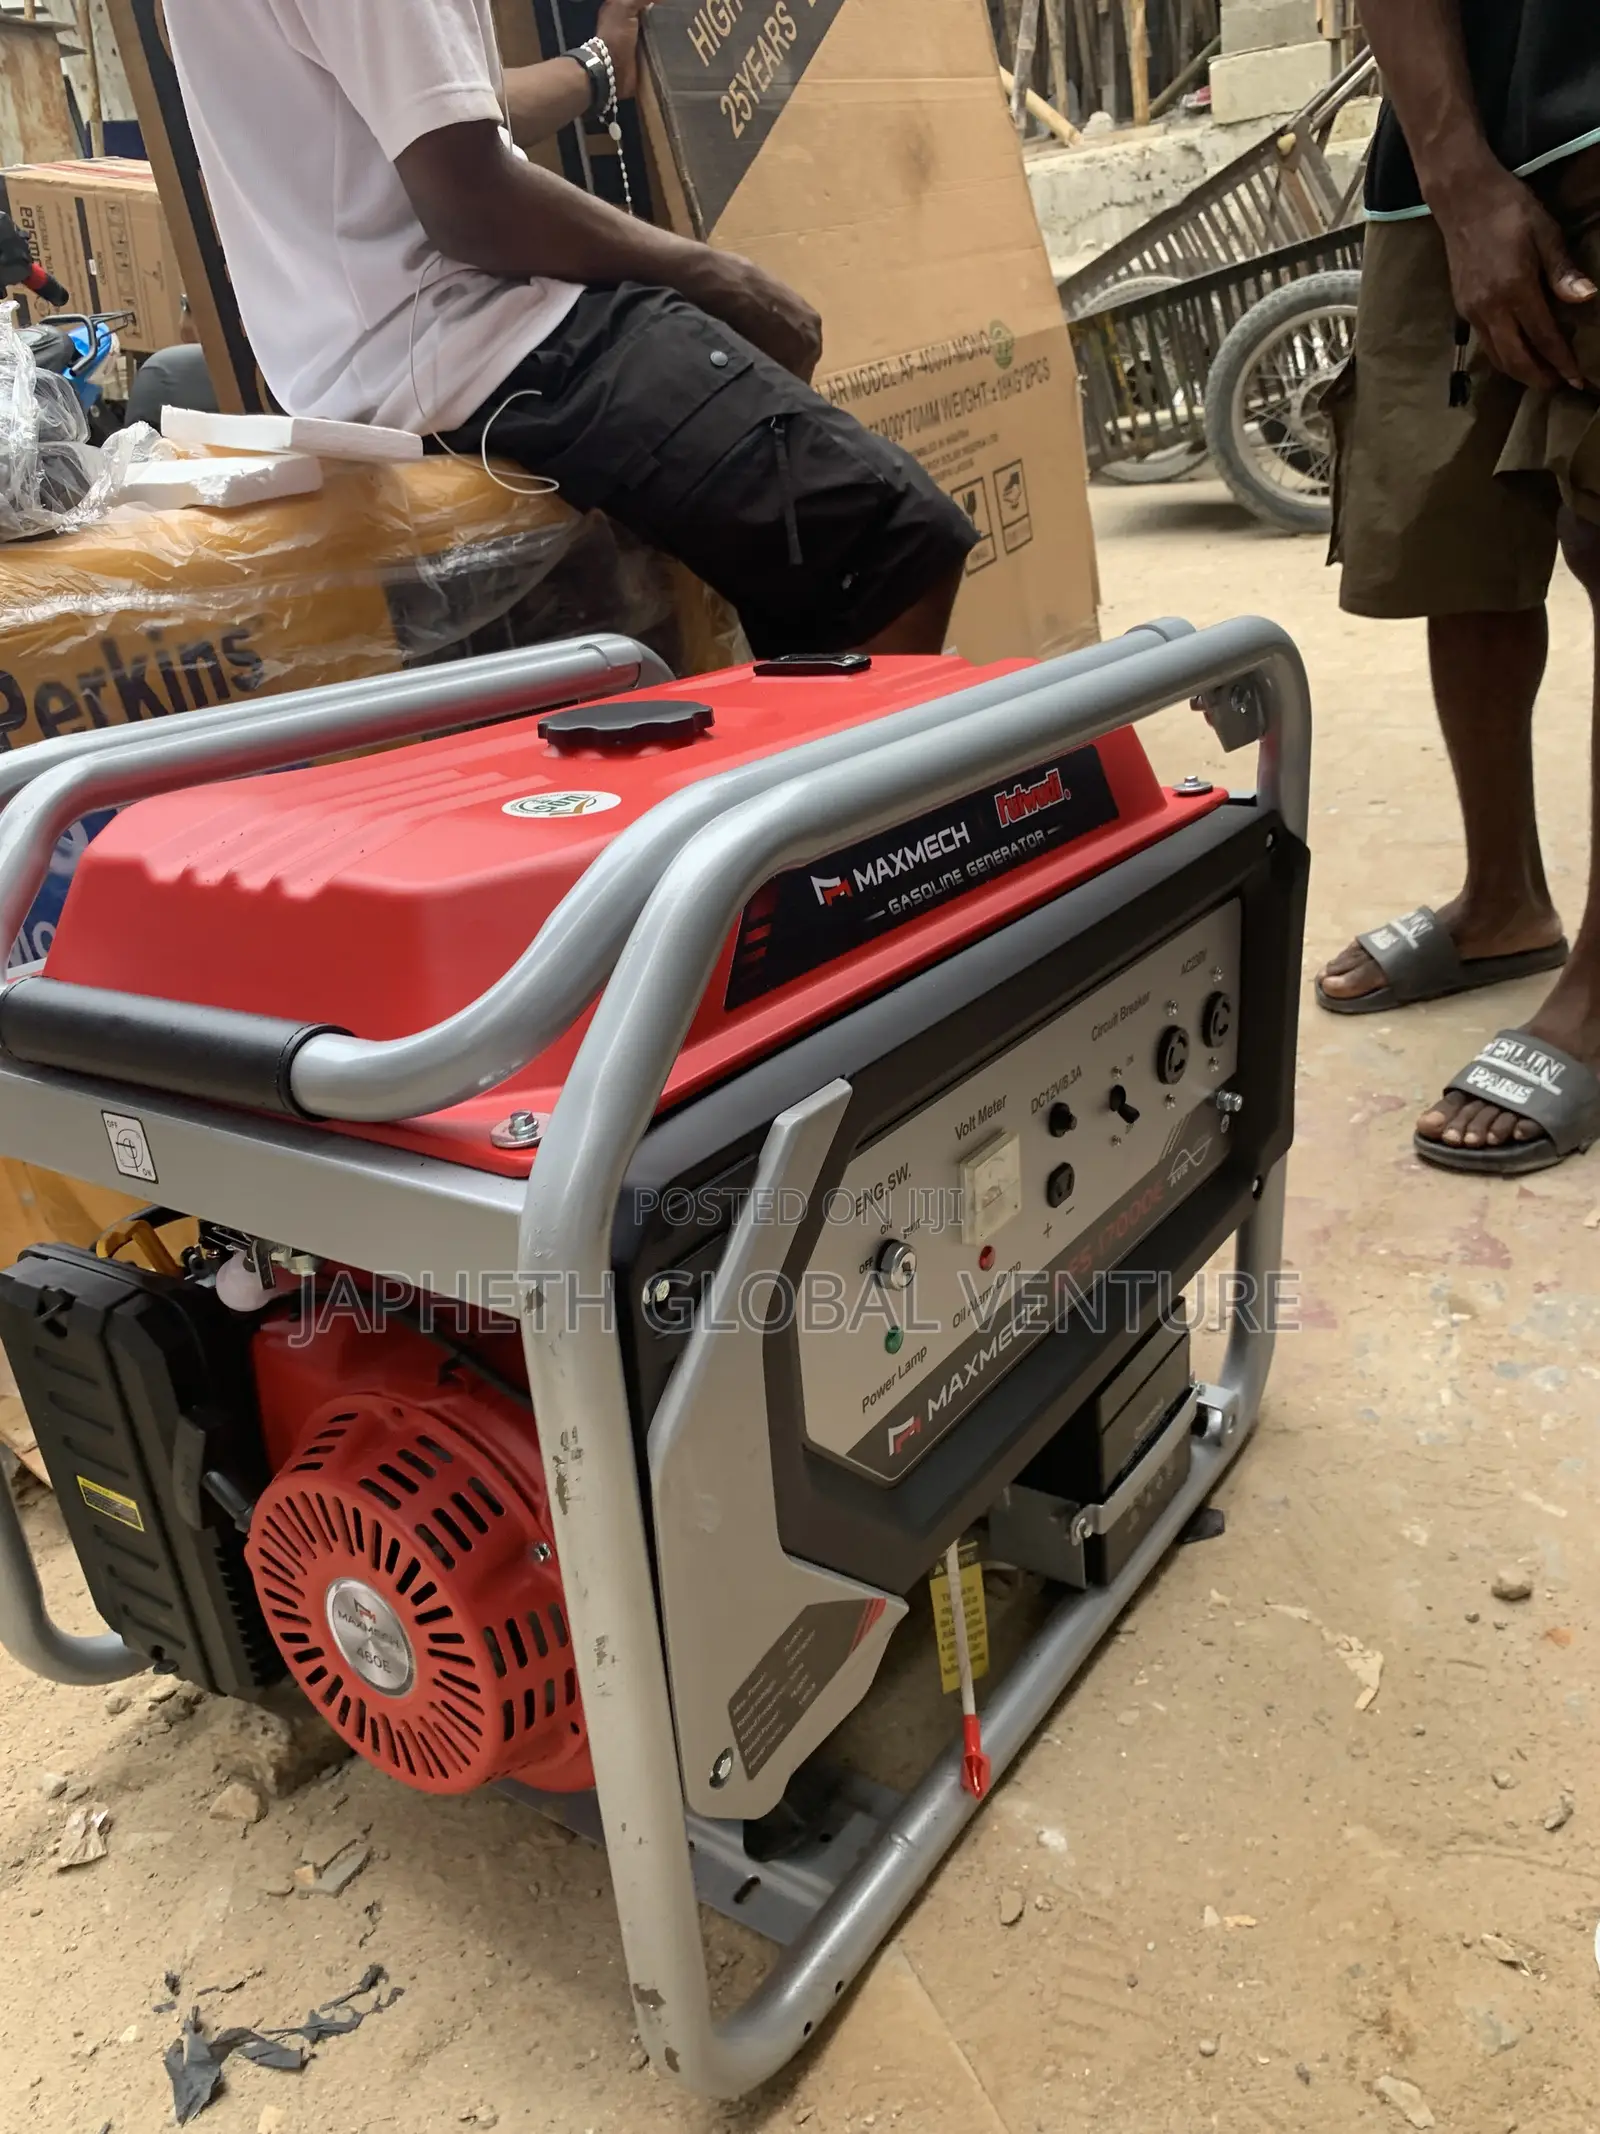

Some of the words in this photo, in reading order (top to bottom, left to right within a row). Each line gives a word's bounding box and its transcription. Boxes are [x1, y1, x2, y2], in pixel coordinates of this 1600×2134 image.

[720, 0, 797, 139] 25YEARS
[0, 625, 265, 753] Perkins
[853, 821, 971, 892] MAXMECH
[888, 867, 964, 916] GASOLINE
[966, 829, 1046, 877] GENERATOR
[1091, 1012, 1119, 1041] Circuit
[1120, 990, 1151, 1021] Breaker
[955, 1114, 976, 1141] Volt
[978, 1094, 1008, 1126] Meter
[880, 1217, 893, 1236] ON
[858, 1256, 874, 1275] OFF
[952, 1307, 967, 1328] Oil
[861, 1373, 896, 1414] Power
[898, 1346, 928, 1379] Lamp
[927, 1294, 1042, 1422] MAXMECH
[337, 1609, 400, 1649] MAXMECH
[356, 1646, 392, 1674] 460E
